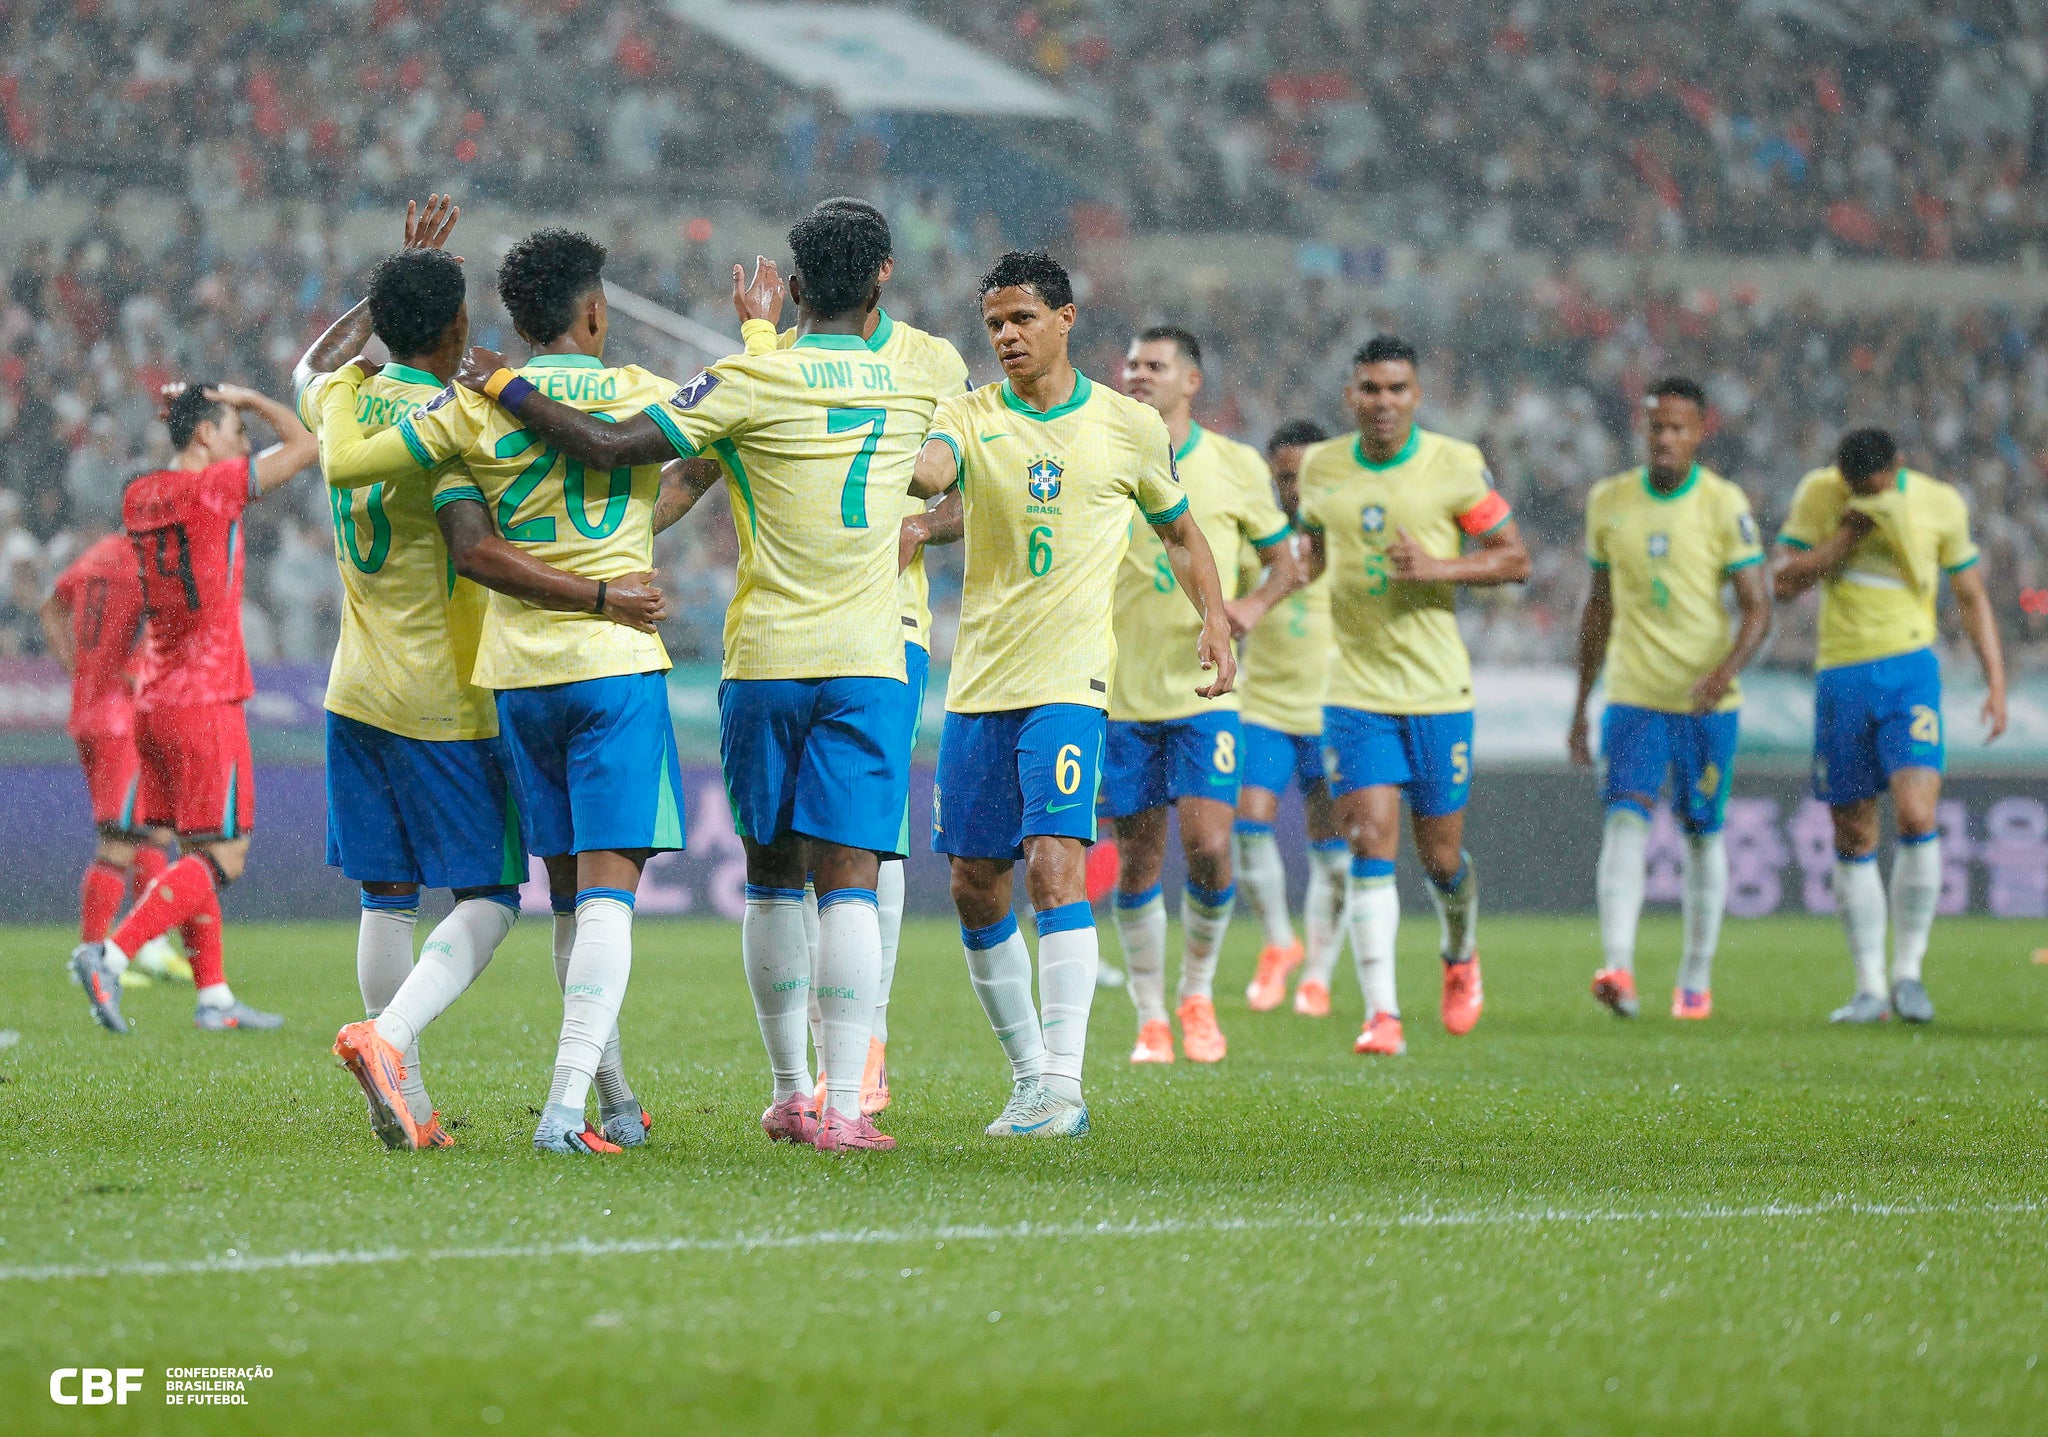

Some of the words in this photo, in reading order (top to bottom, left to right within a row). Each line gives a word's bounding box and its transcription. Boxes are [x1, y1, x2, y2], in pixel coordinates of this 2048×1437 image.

[799, 361, 853, 389] VINI
[859, 362, 898, 392] JR.
[495, 412, 632, 542] 20
[827, 408, 887, 528] 7
[1026, 504, 1062, 515] BRASIL
[1028, 525, 1054, 578] 6
[1154, 553, 1175, 593] 8
[1365, 554, 1388, 596] 5
[1055, 744, 1082, 795] 6
[1213, 731, 1235, 773] 8
[1451, 742, 1469, 784] 5
